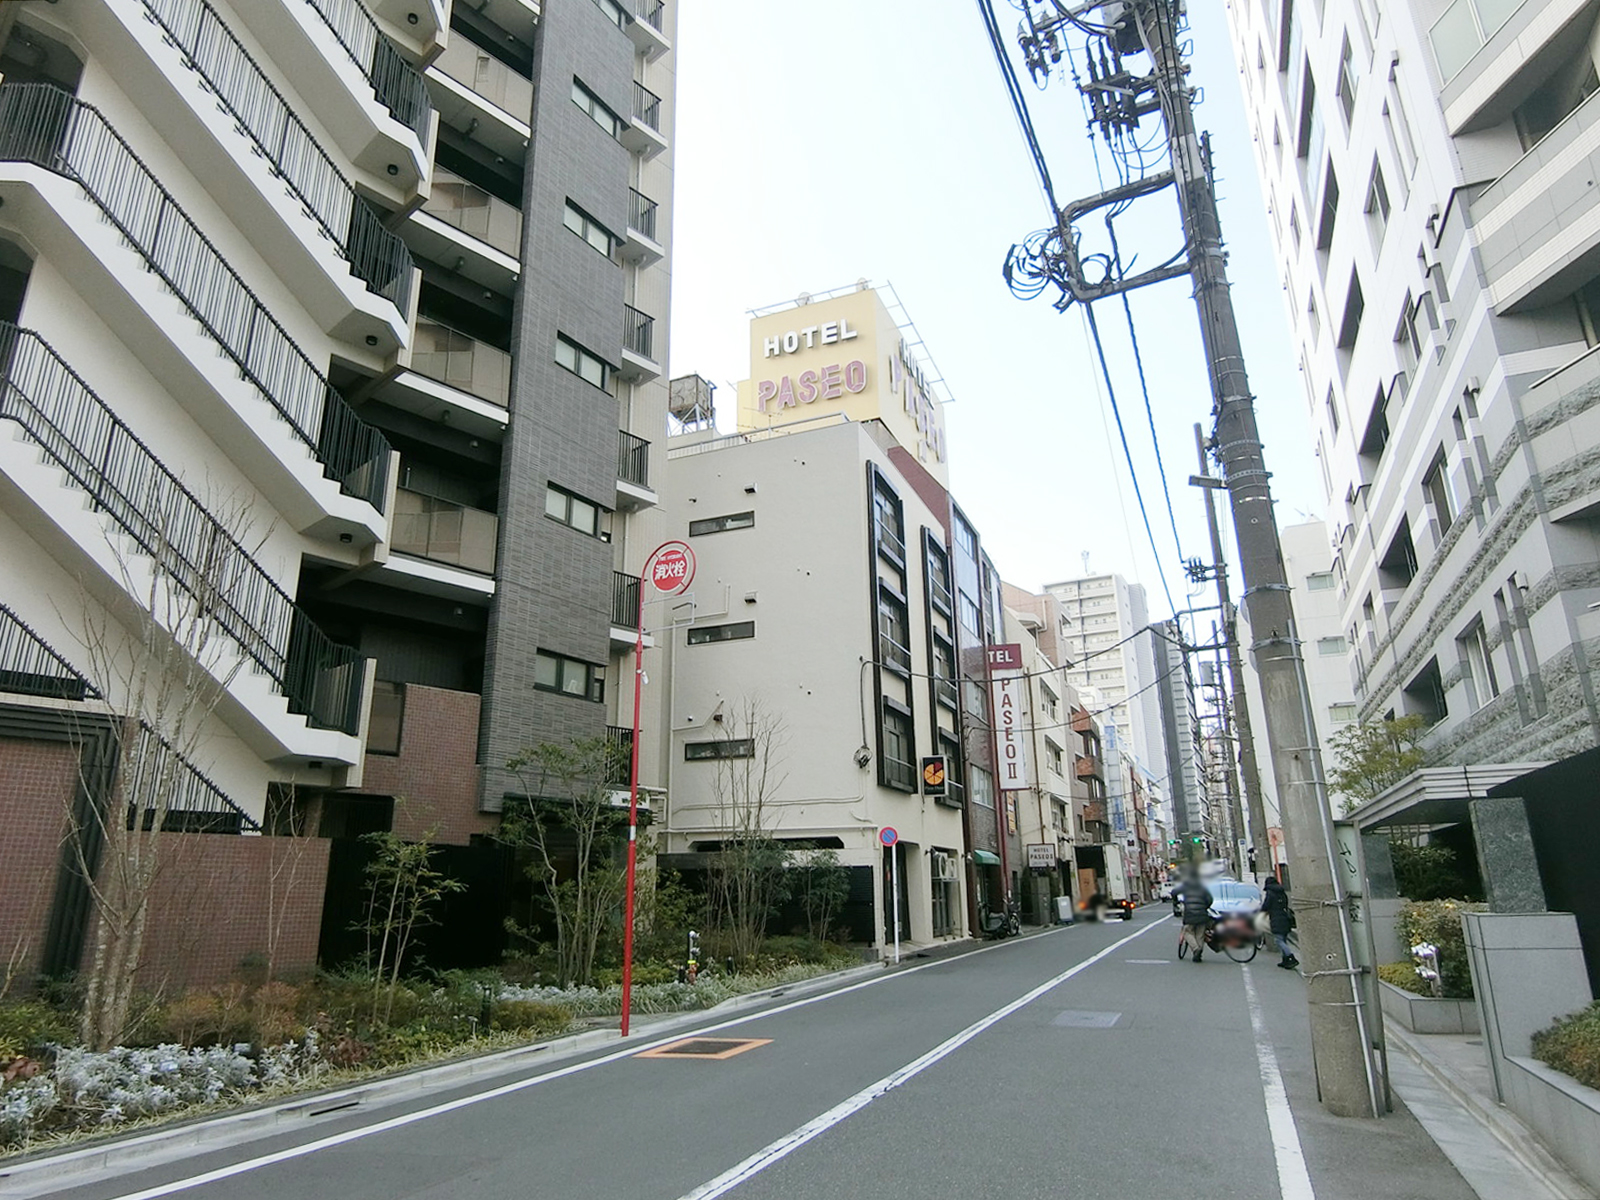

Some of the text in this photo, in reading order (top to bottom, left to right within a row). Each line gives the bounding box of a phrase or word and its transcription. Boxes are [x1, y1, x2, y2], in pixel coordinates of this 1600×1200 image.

[764, 319, 857, 358] HOTEL
[758, 360, 867, 412] PASEO
[655, 560, 685, 580] 消火栓
[988, 650, 1013, 663] TEL
